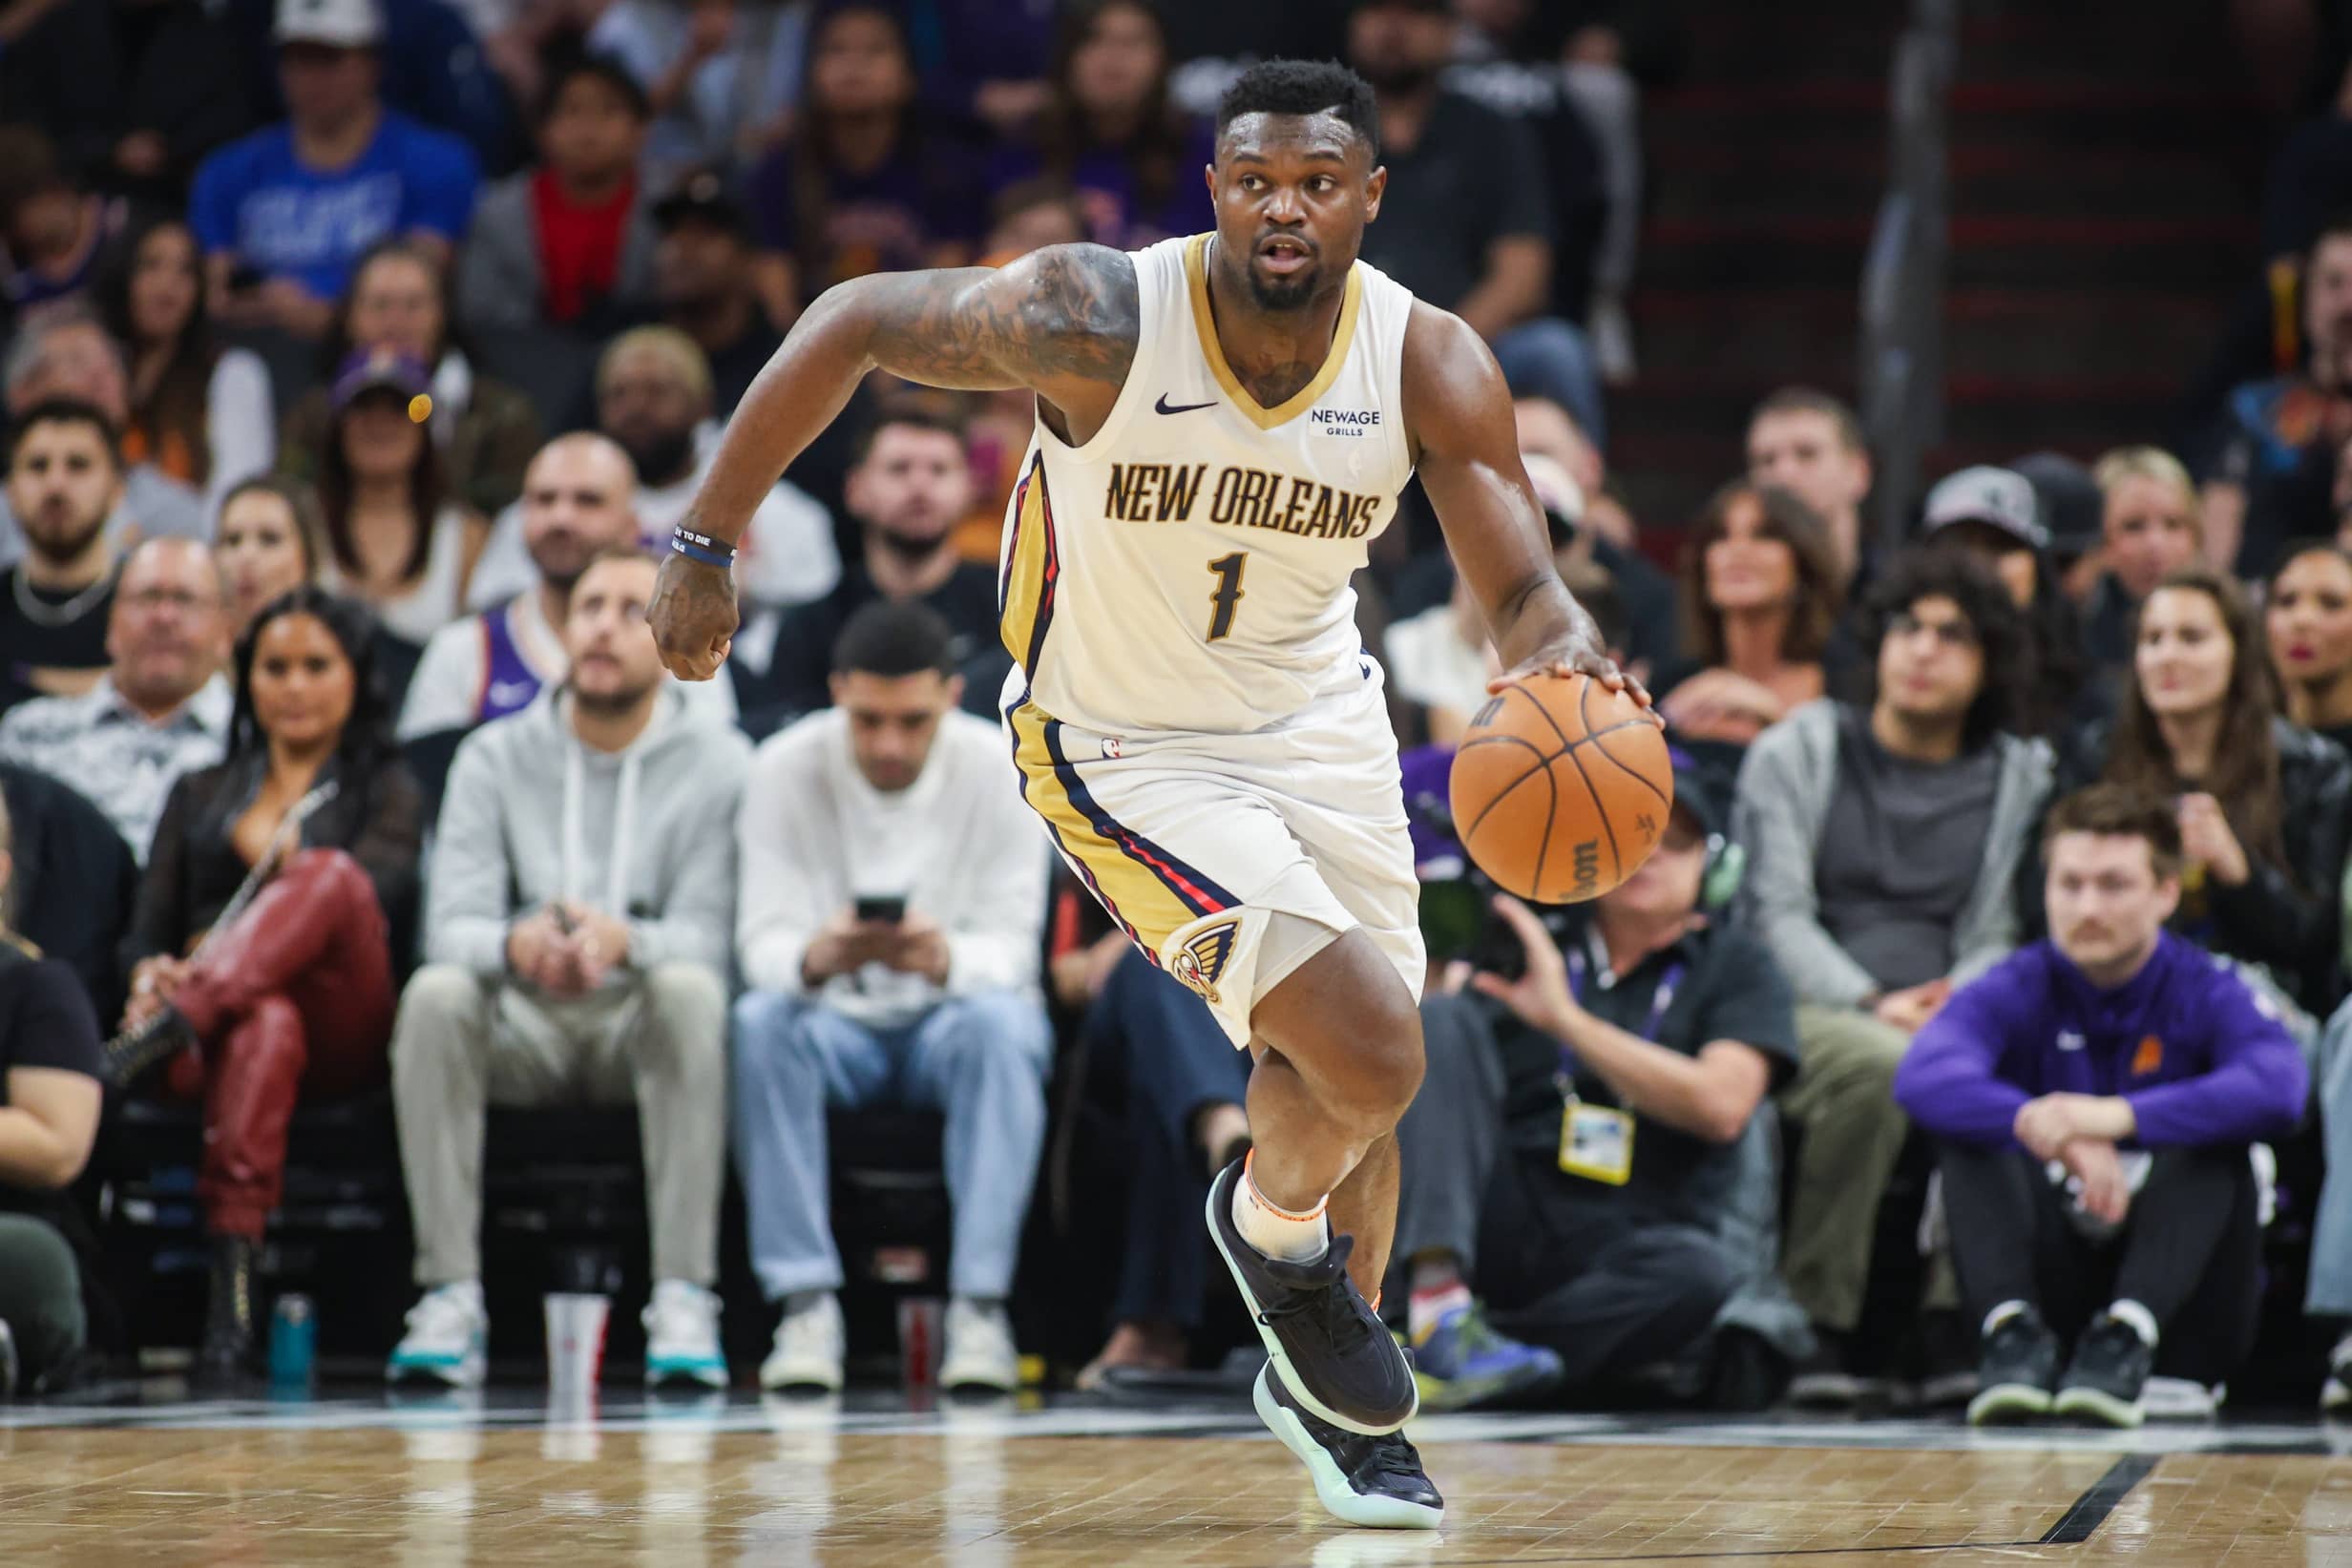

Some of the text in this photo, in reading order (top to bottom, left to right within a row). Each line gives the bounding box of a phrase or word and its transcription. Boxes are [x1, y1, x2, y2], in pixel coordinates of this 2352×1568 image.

[1312, 409, 1380, 425] NEWAGE
[1327, 427, 1363, 436] GRILLS
[1104, 463, 1381, 539] NEW ORLEANS
[682, 530, 695, 541] TO
[695, 533, 711, 547] DIE
[1207, 552, 1249, 643] 1
